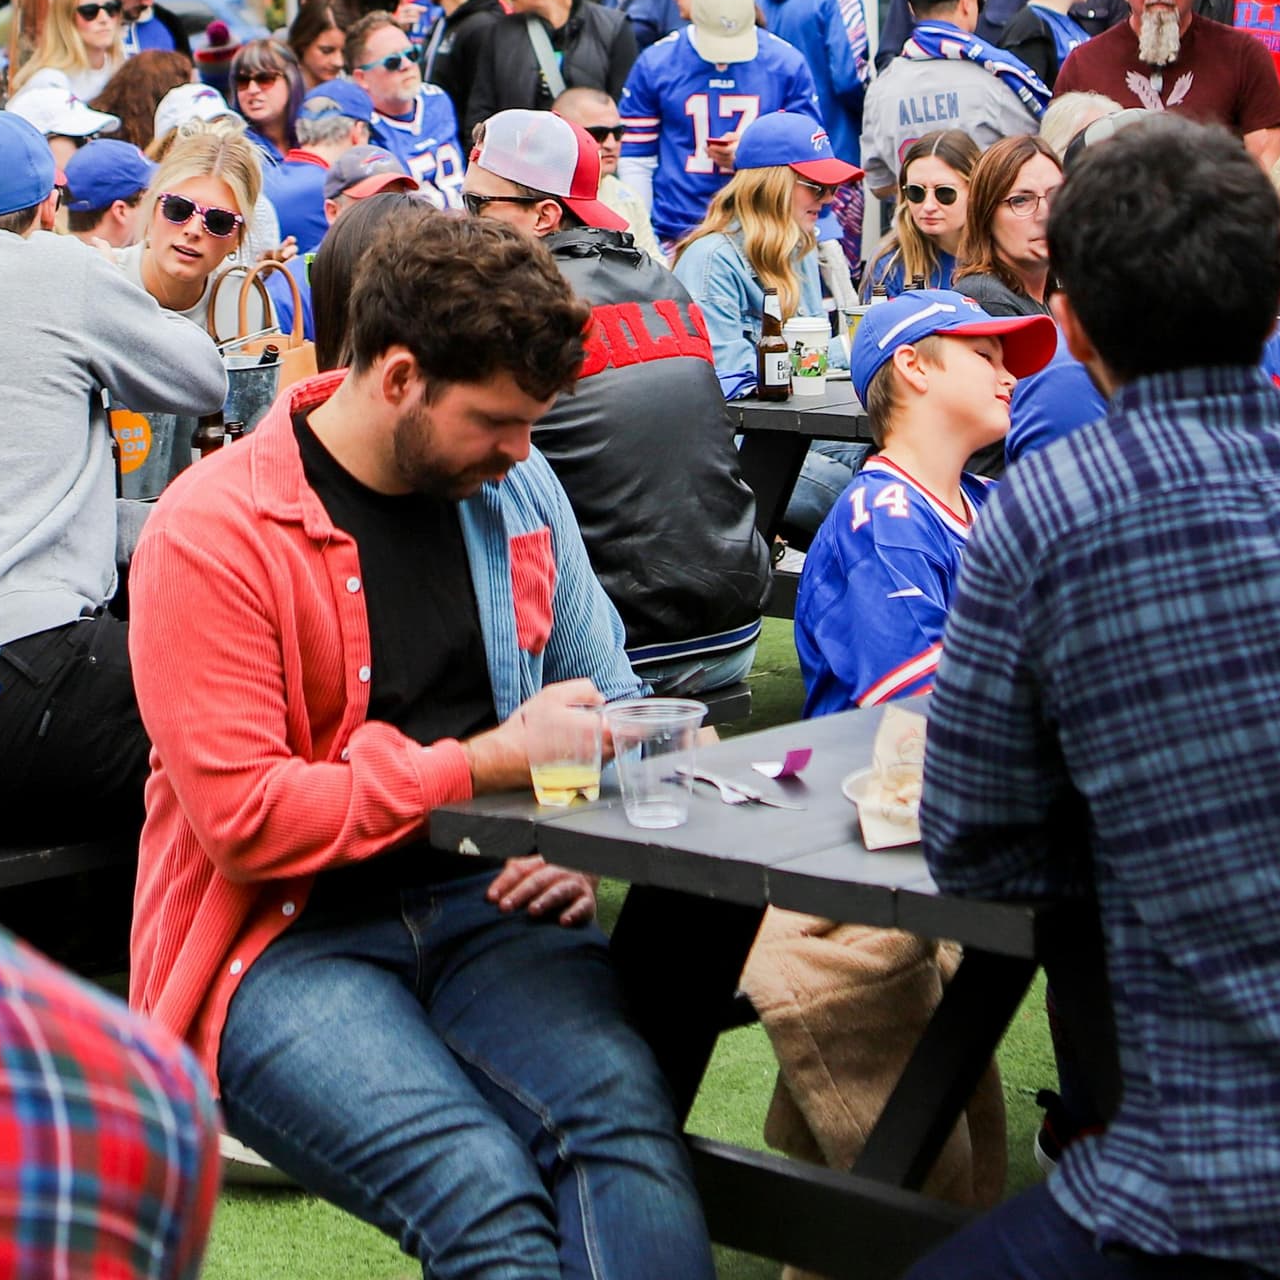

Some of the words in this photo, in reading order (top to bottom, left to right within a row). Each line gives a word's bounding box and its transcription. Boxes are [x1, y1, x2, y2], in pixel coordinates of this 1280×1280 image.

[684, 94, 760, 174] 17
[898, 91, 961, 127] ALLEN
[849, 482, 911, 533] 14
